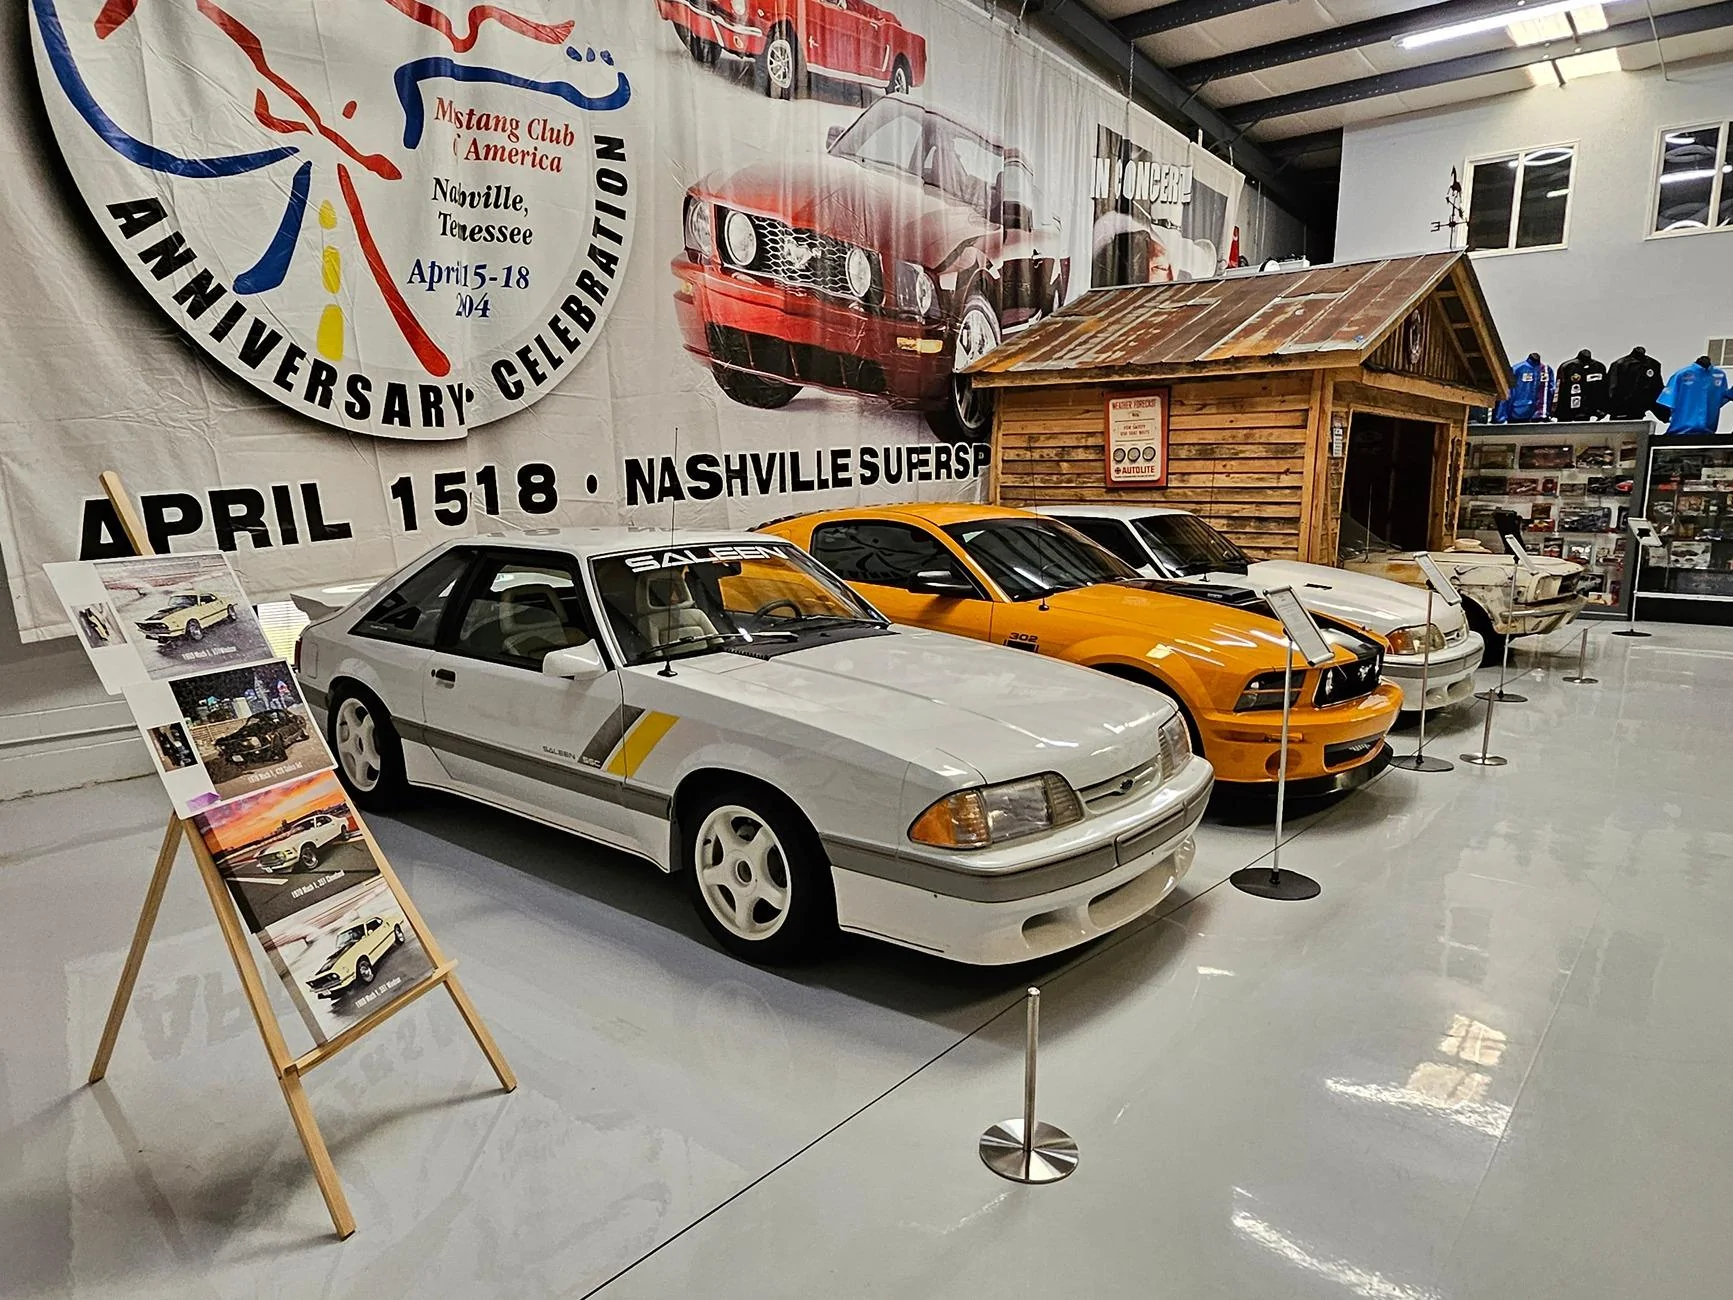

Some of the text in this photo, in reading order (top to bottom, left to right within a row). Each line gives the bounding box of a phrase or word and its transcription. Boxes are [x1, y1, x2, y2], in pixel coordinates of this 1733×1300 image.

[527, 118, 575, 147] Club
[464, 137, 563, 173] America
[491, 133, 628, 401] CELEBRATION
[106, 198, 467, 427] ANNIVERSARY
[1121, 465, 1155, 474] AUTOLITE
[79, 482, 353, 561] APRIL
[624, 448, 853, 506] NASHVILLE
[625, 545, 789, 573] SALEEN
[1008, 632, 1038, 643] 302
